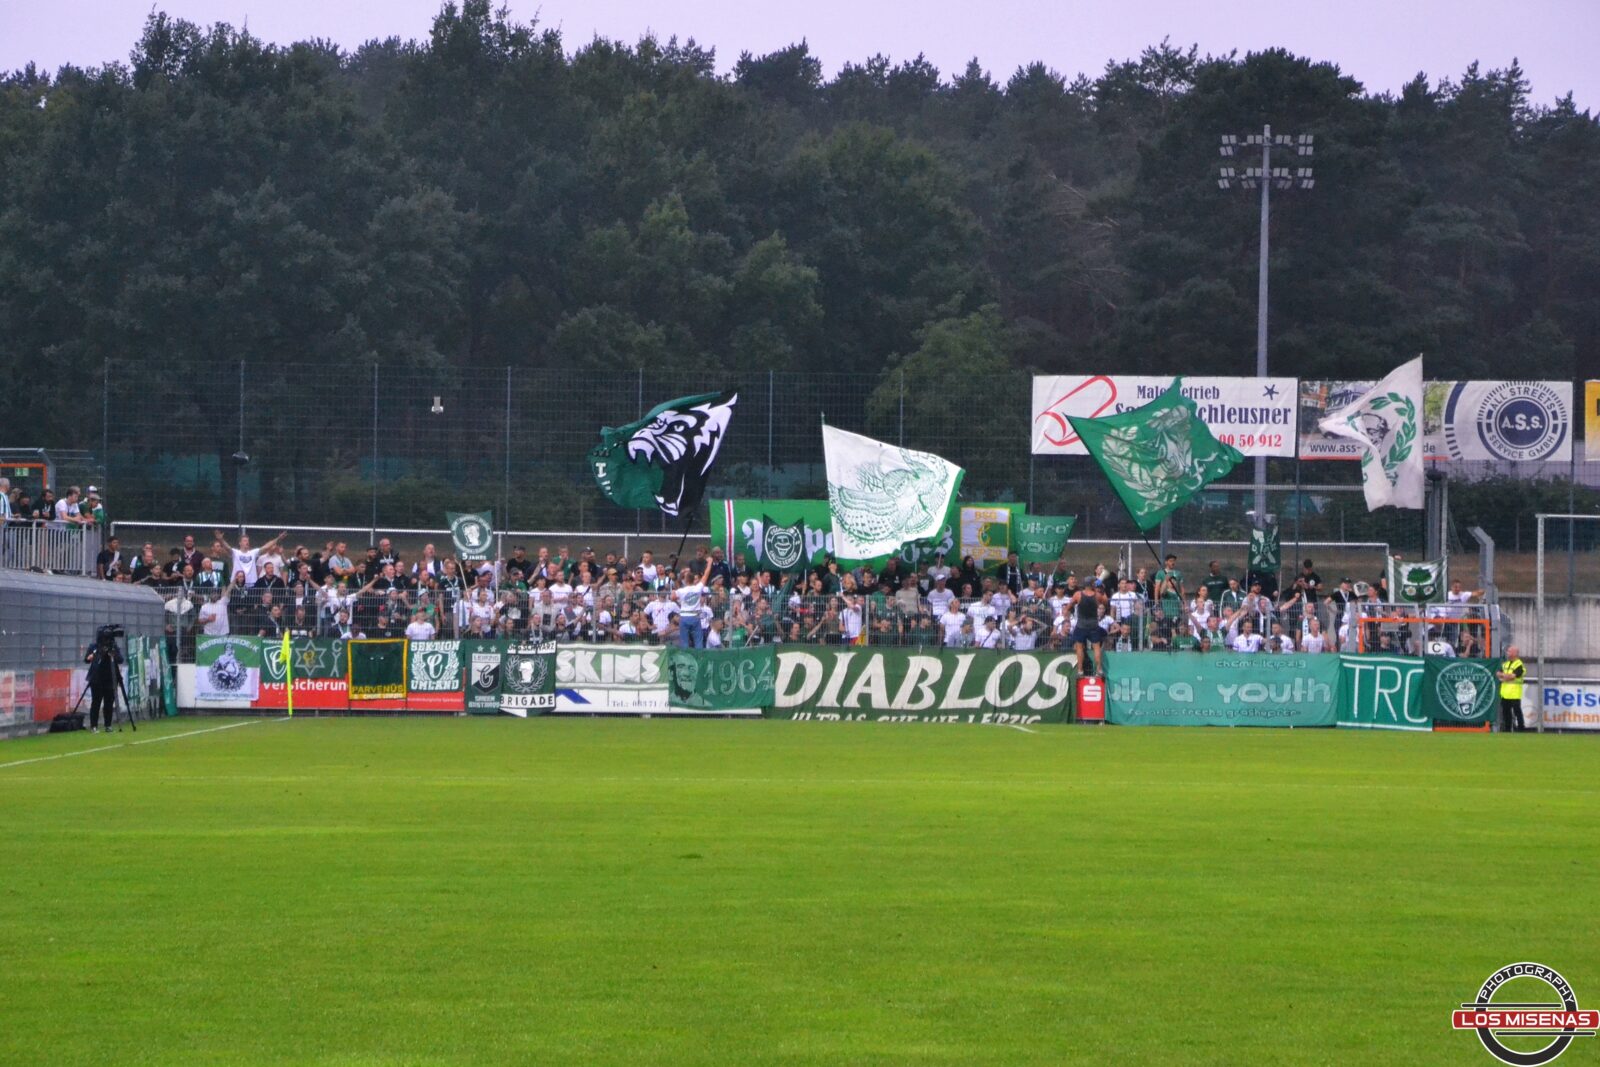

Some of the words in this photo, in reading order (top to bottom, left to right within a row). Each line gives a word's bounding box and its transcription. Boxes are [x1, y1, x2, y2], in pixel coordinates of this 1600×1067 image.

[1137, 385, 1220, 399] Maleetrieb
[1490, 393, 1508, 411] ALL
[1509, 386, 1556, 410] STREETS
[1198, 404, 1291, 425] chleusner
[1501, 413, 1543, 431] A.S.S.
[1259, 434, 1282, 447] 912
[1489, 434, 1524, 459] SERVICE
[1528, 435, 1555, 457] GMBH
[410, 640, 460, 651] SEKTION
[555, 650, 661, 684] SKINS
[263, 678, 349, 691] vericherun
[410, 679, 460, 691] UMLAND
[704, 657, 776, 697] 1964
[776, 651, 1078, 711] DIABLOS
[500, 695, 554, 706] BRIGADE
[1543, 687, 1600, 707] Reis
